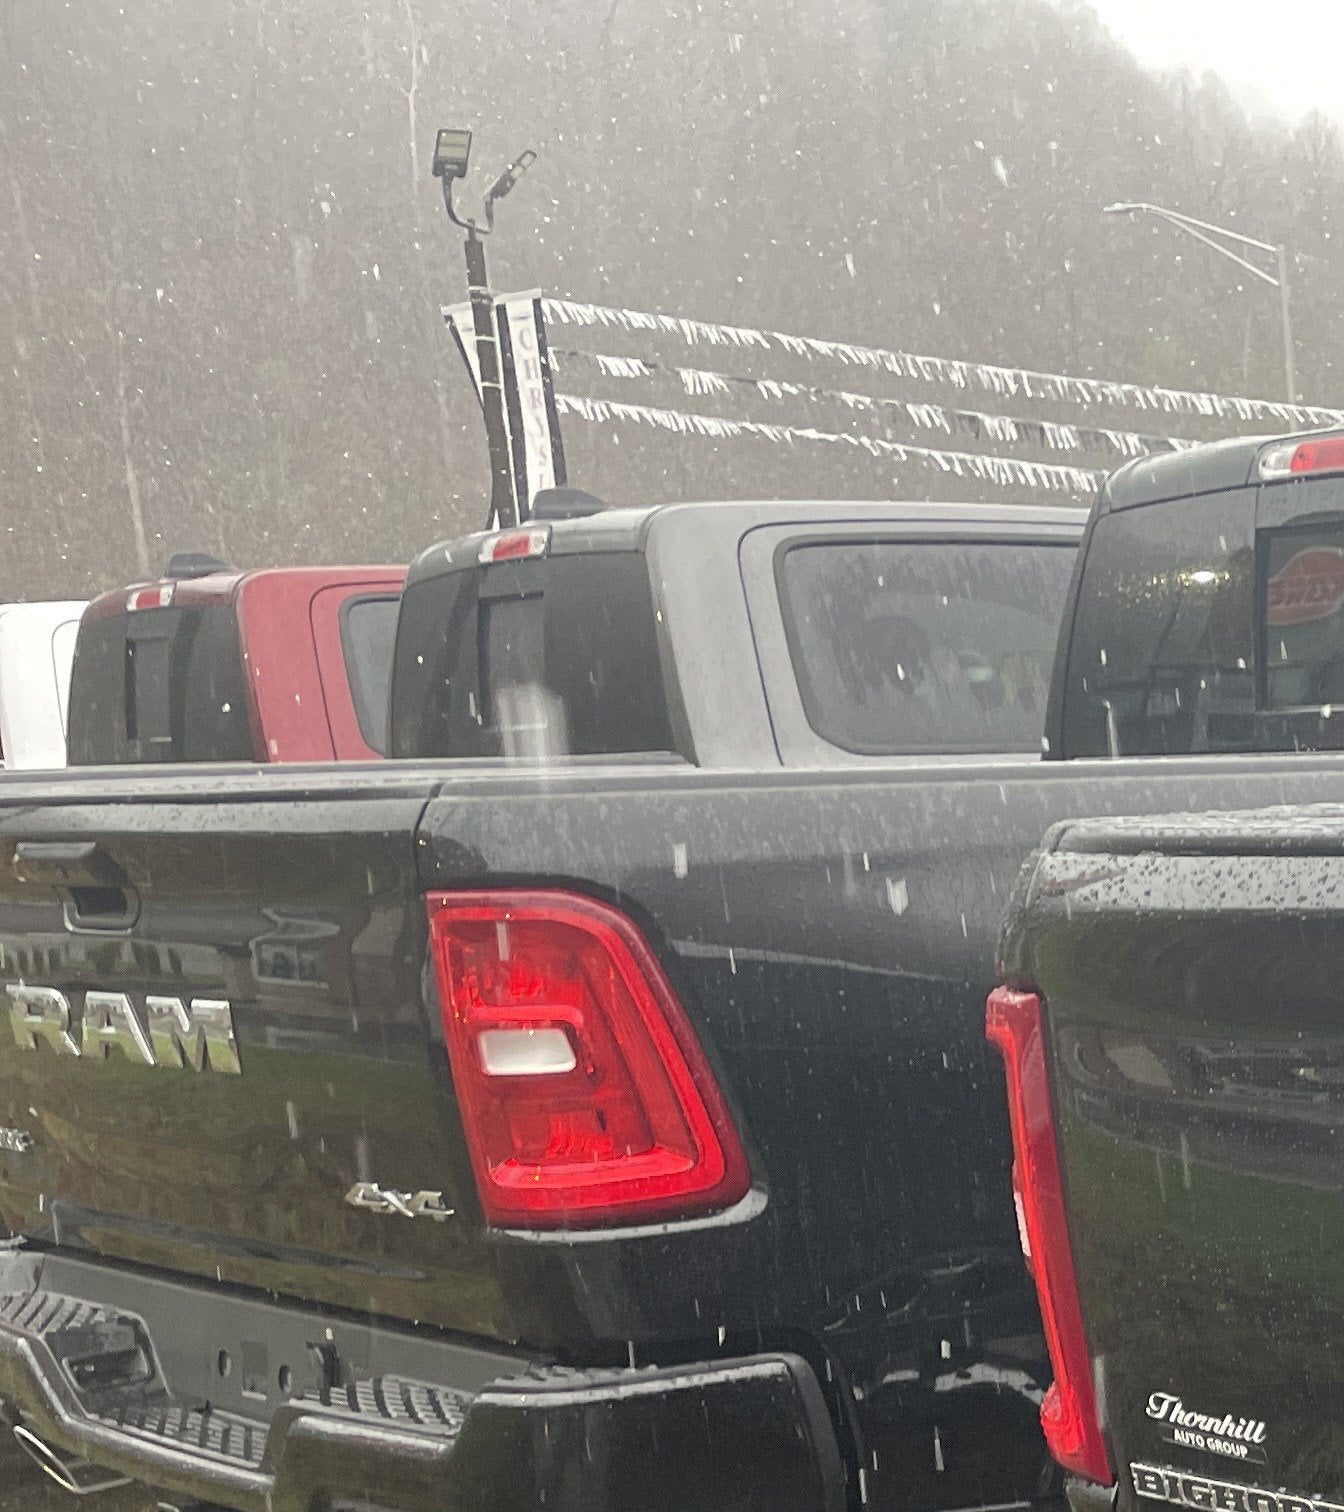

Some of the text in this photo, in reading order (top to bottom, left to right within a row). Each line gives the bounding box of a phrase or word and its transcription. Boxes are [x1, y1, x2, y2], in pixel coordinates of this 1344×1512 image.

[6, 984, 241, 1074] RAM
[1145, 1392, 1266, 1443] Thornhill
[1174, 1428, 1248, 1458] AUTO GROUP
